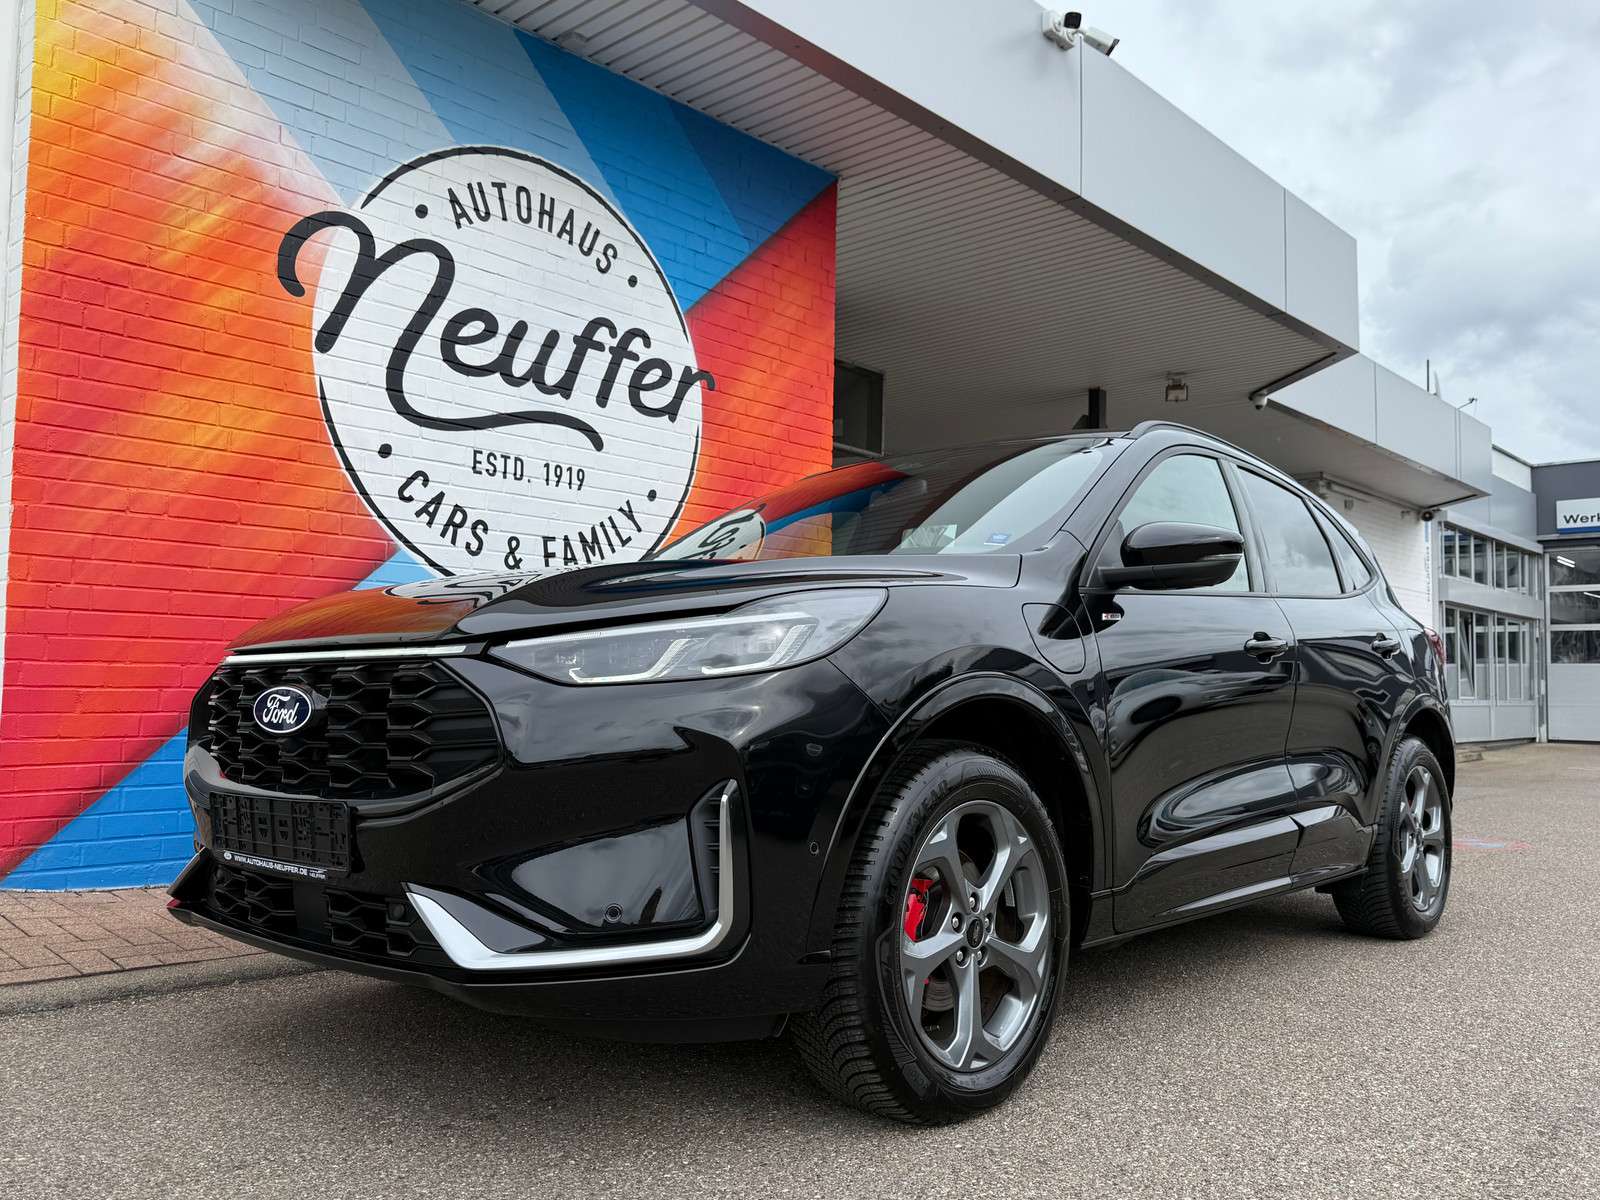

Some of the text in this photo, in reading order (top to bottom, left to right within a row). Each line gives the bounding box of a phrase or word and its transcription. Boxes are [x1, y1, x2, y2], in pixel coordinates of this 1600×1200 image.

[448, 181, 619, 275] AUTOHAUS
[472, 449, 586, 491] ESTD. 1919
[397, 470, 642, 570] CARS & FAMILY
[262, 693, 299, 725] Ford
